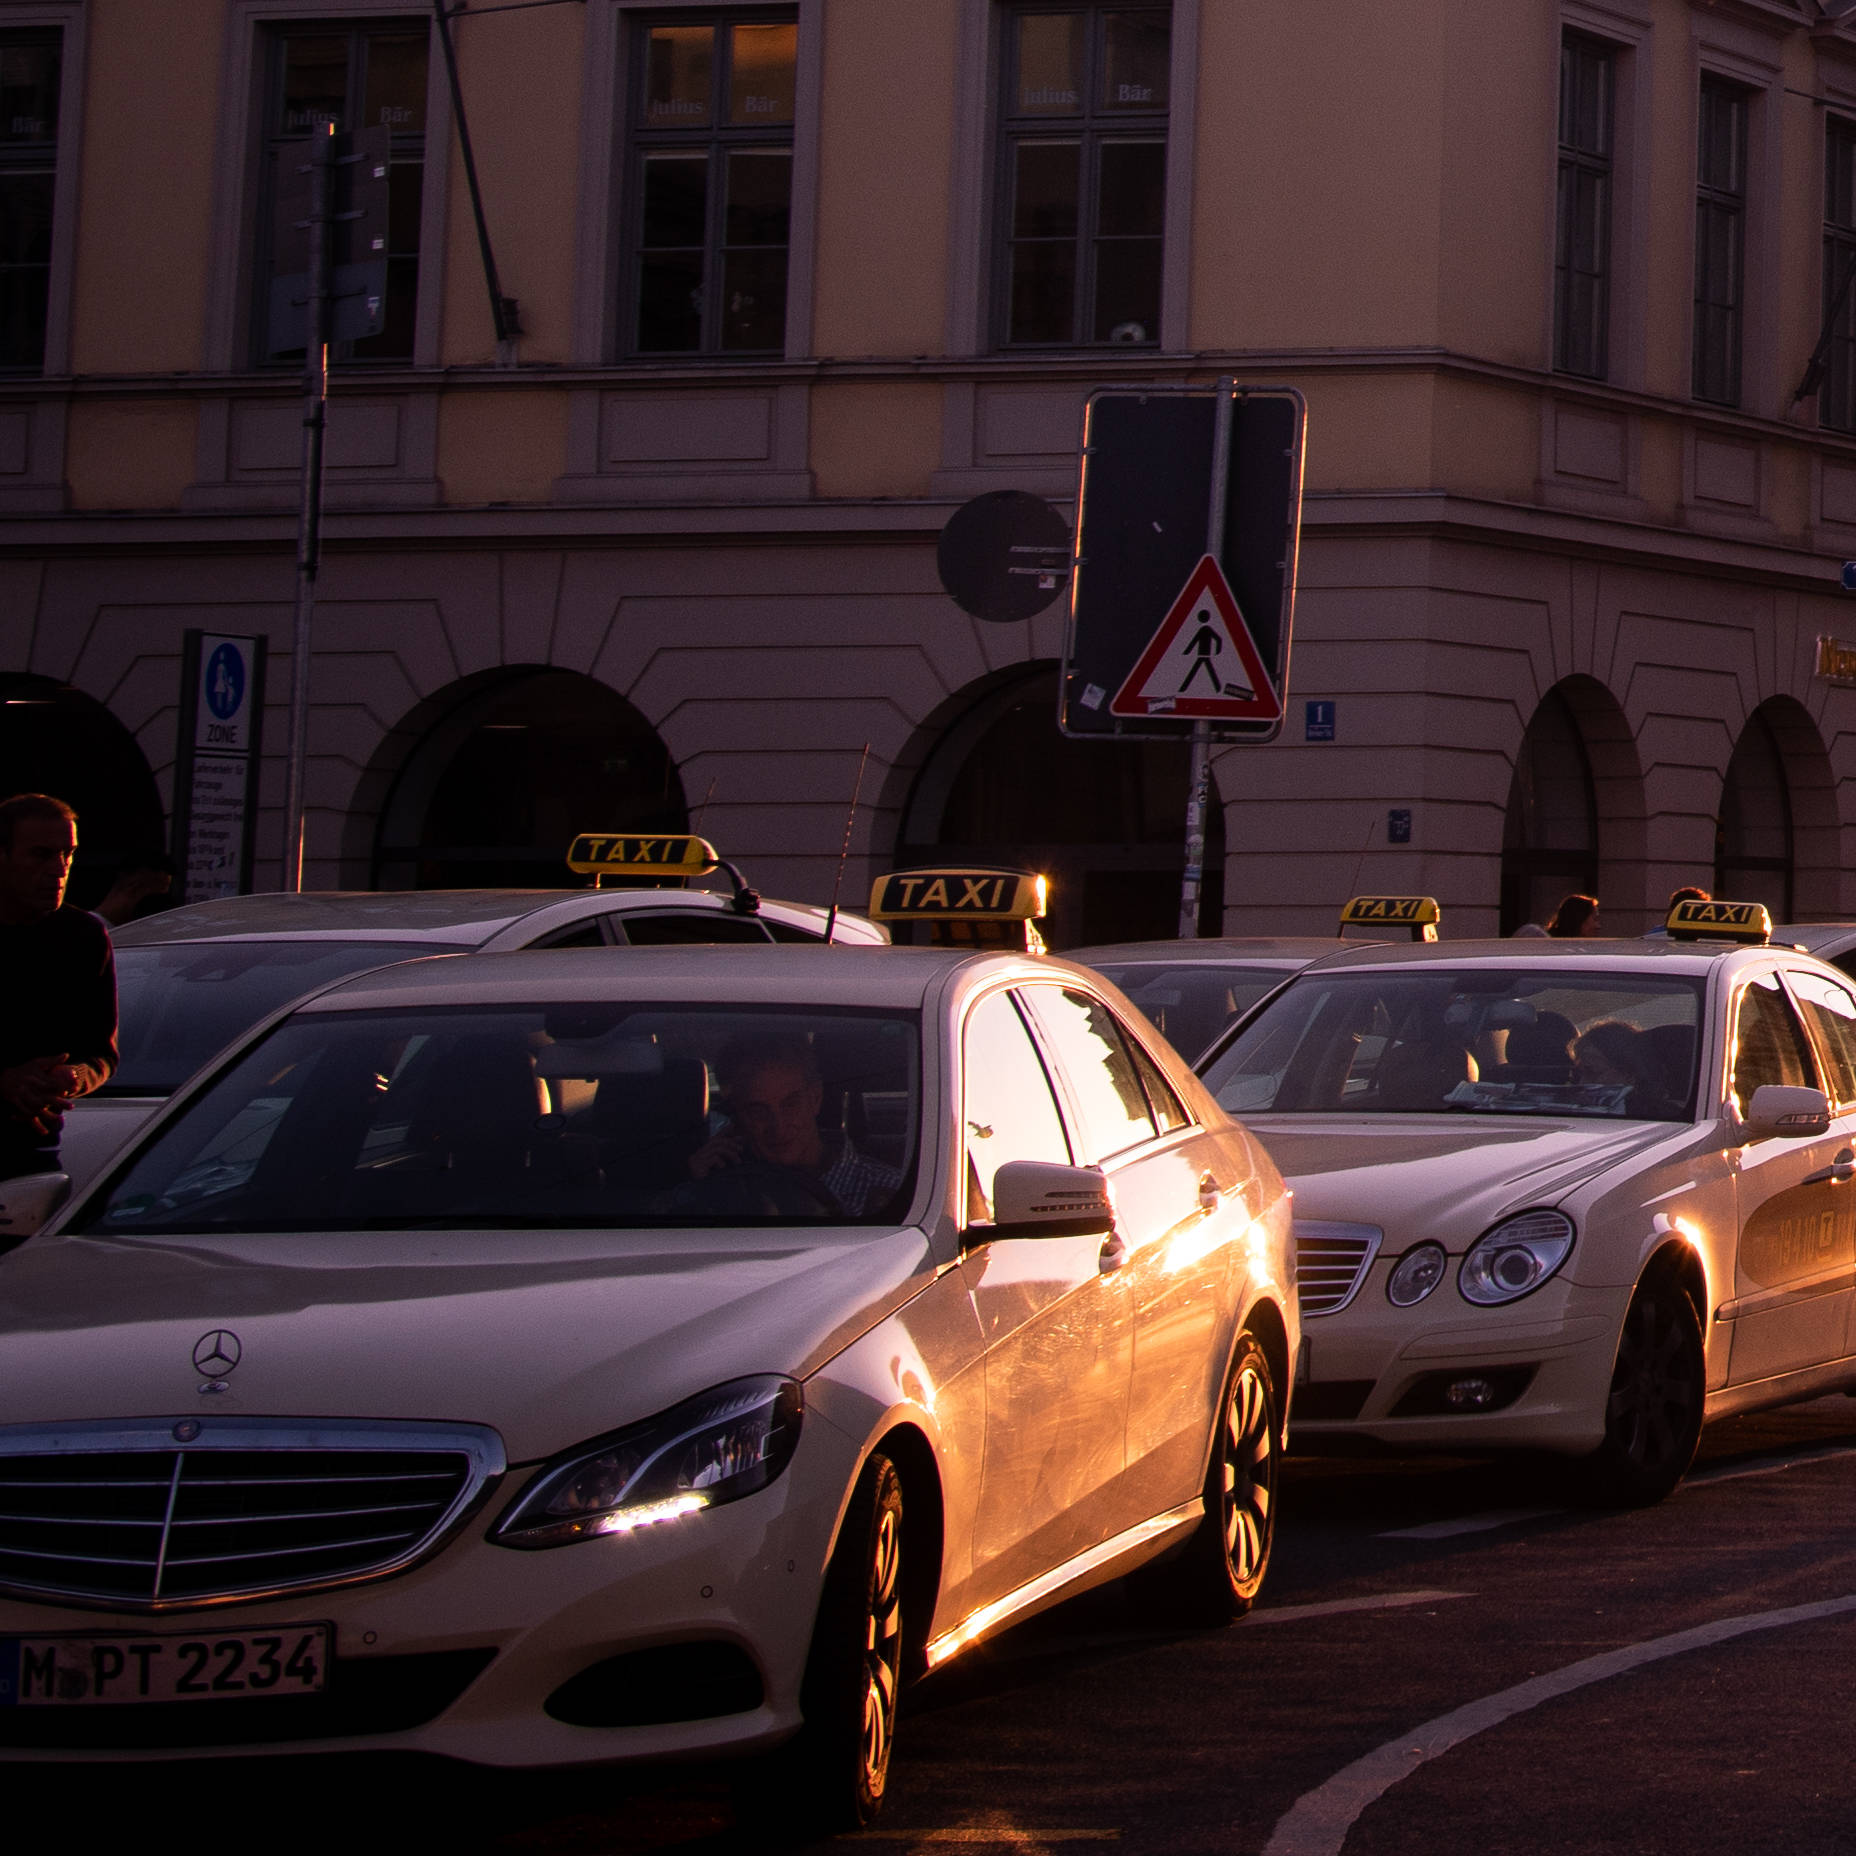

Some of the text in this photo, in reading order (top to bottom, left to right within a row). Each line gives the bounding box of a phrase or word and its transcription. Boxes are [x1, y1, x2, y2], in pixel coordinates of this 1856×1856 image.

[207, 724, 238, 744] ZONE
[588, 839, 671, 864] TAXI
[902, 877, 1006, 910] TAXI
[1356, 899, 1418, 917] TAXI
[1685, 903, 1751, 924] TAXI
[22, 1646, 56, 1697] M
[93, 1644, 163, 1696] PT
[175, 1634, 318, 1694] 2234
